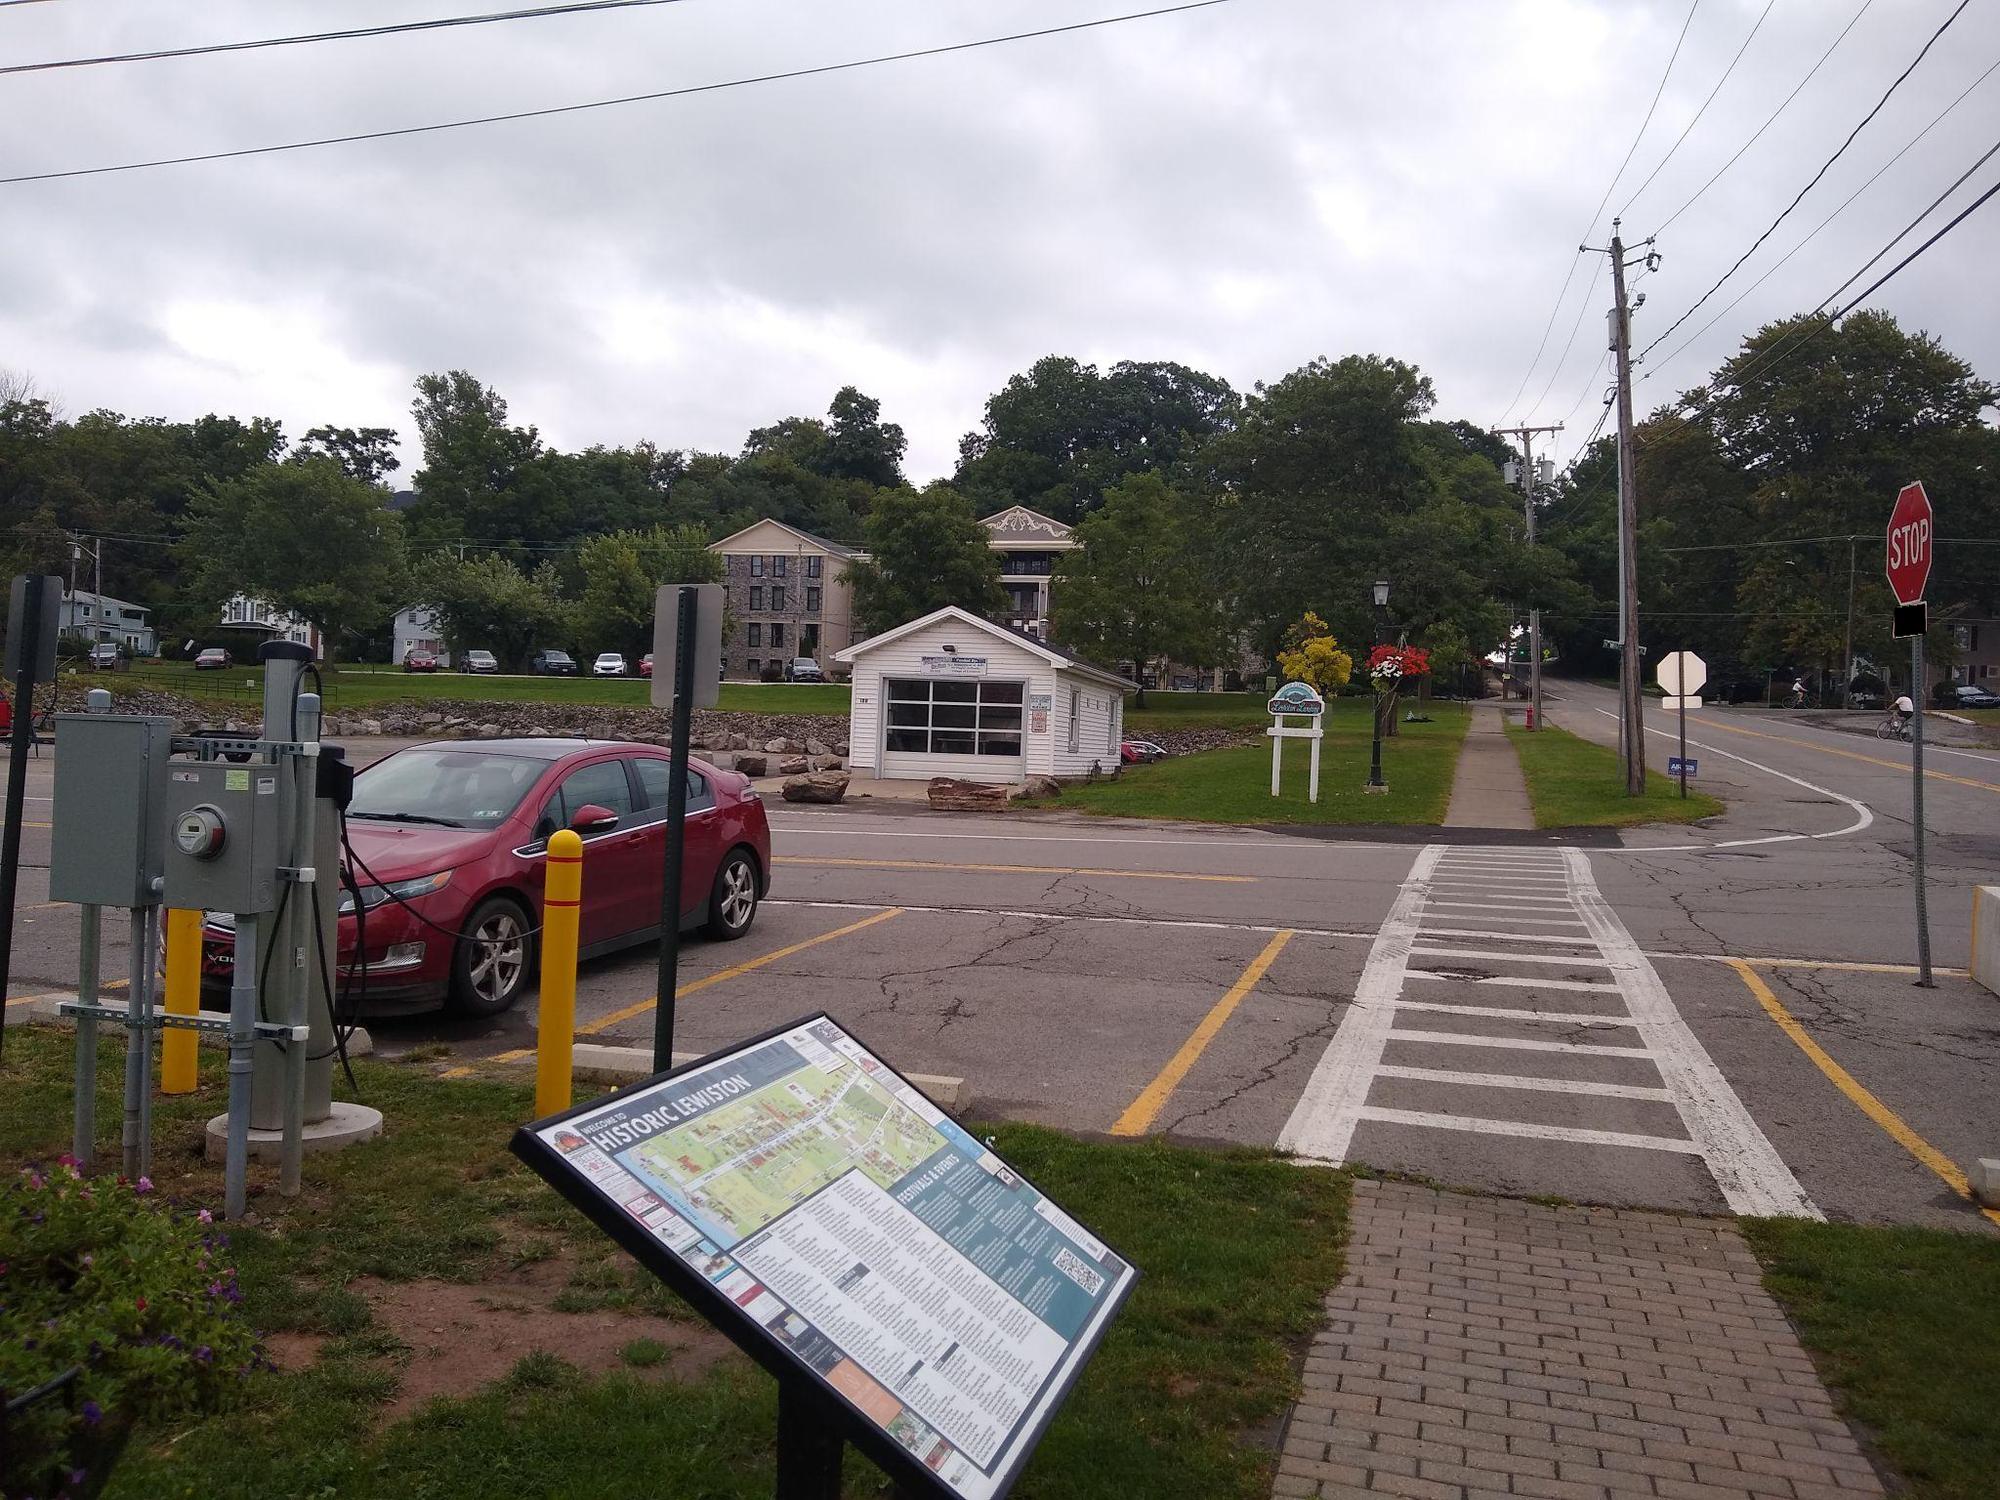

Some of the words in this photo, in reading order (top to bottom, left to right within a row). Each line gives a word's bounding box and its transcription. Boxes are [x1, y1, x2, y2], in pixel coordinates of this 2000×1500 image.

[1891, 518, 1929, 570] STOP
[580, 1117, 618, 1135] WELCOME
[615, 1112, 628, 1122] TO
[591, 1105, 681, 1152] HISTORIC
[670, 1073, 753, 1117] LEWISTON
[928, 1170, 940, 1180] &
[933, 1152, 960, 1176] EVENTS
[897, 1174, 934, 1205] FESTIVALS
